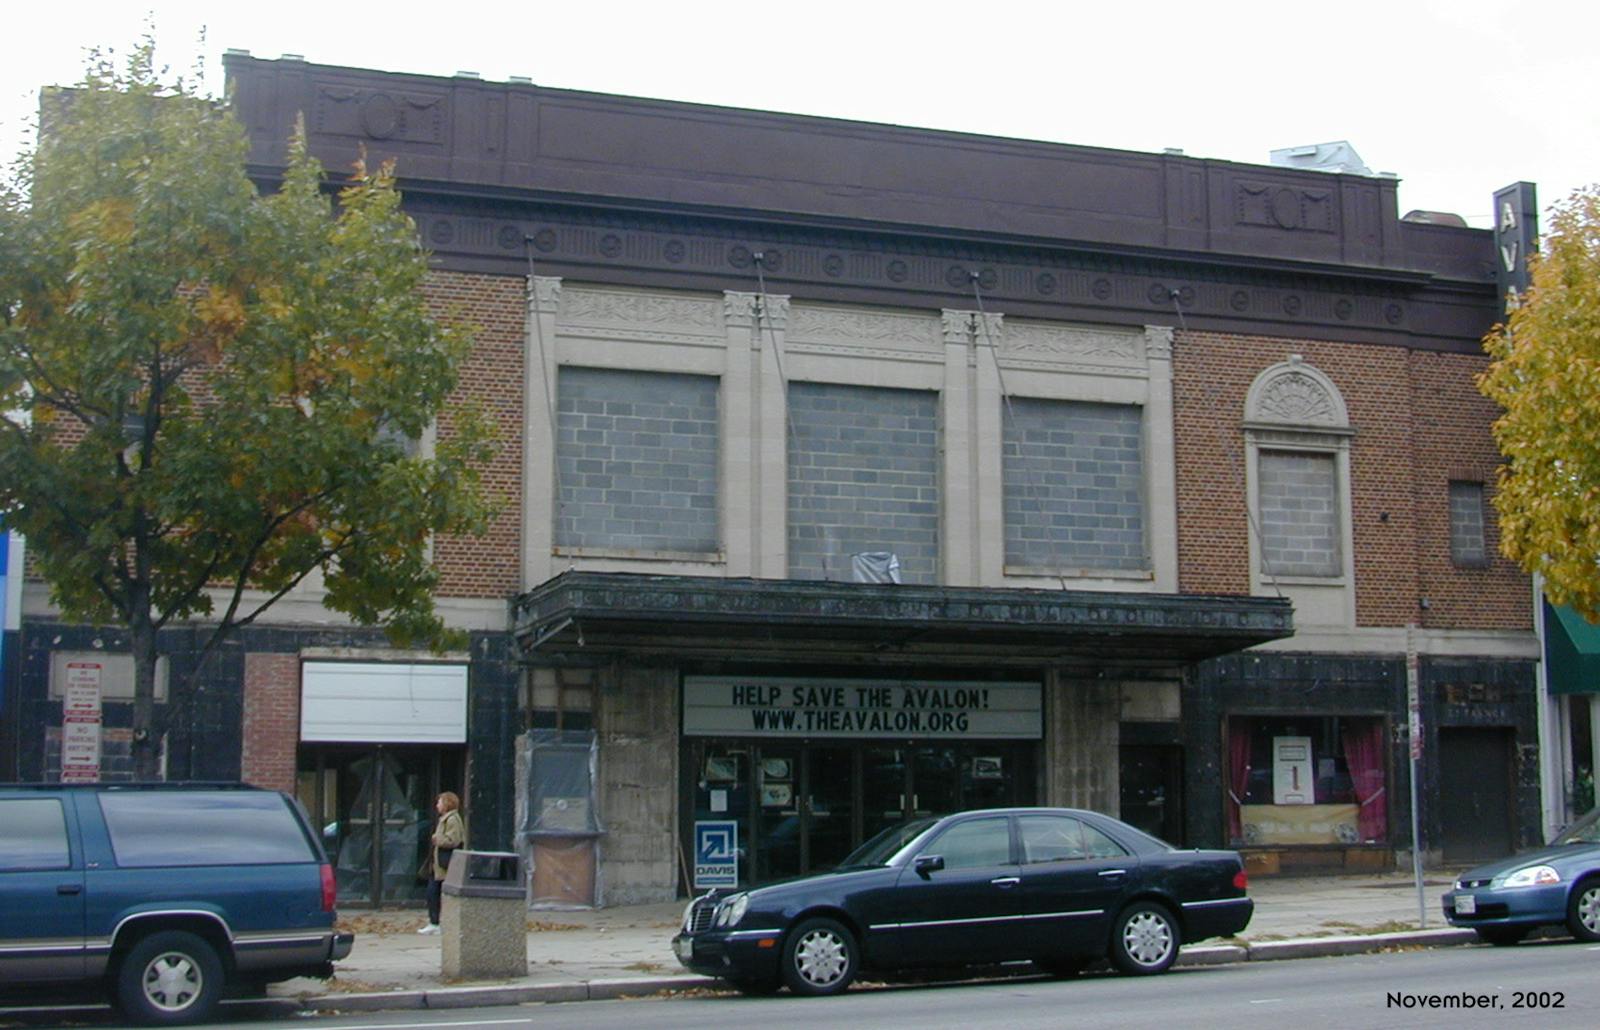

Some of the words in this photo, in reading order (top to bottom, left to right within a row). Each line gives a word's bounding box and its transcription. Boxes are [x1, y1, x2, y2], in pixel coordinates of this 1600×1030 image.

[732, 685, 780, 707] HELP
[793, 686, 845, 708] SAVE
[856, 687, 892, 709] THE
[903, 687, 989, 710] AVALON!
[752, 709, 969, 731] WWW.THEAVALON.ORG
[696, 866, 735, 875] DAVIS
